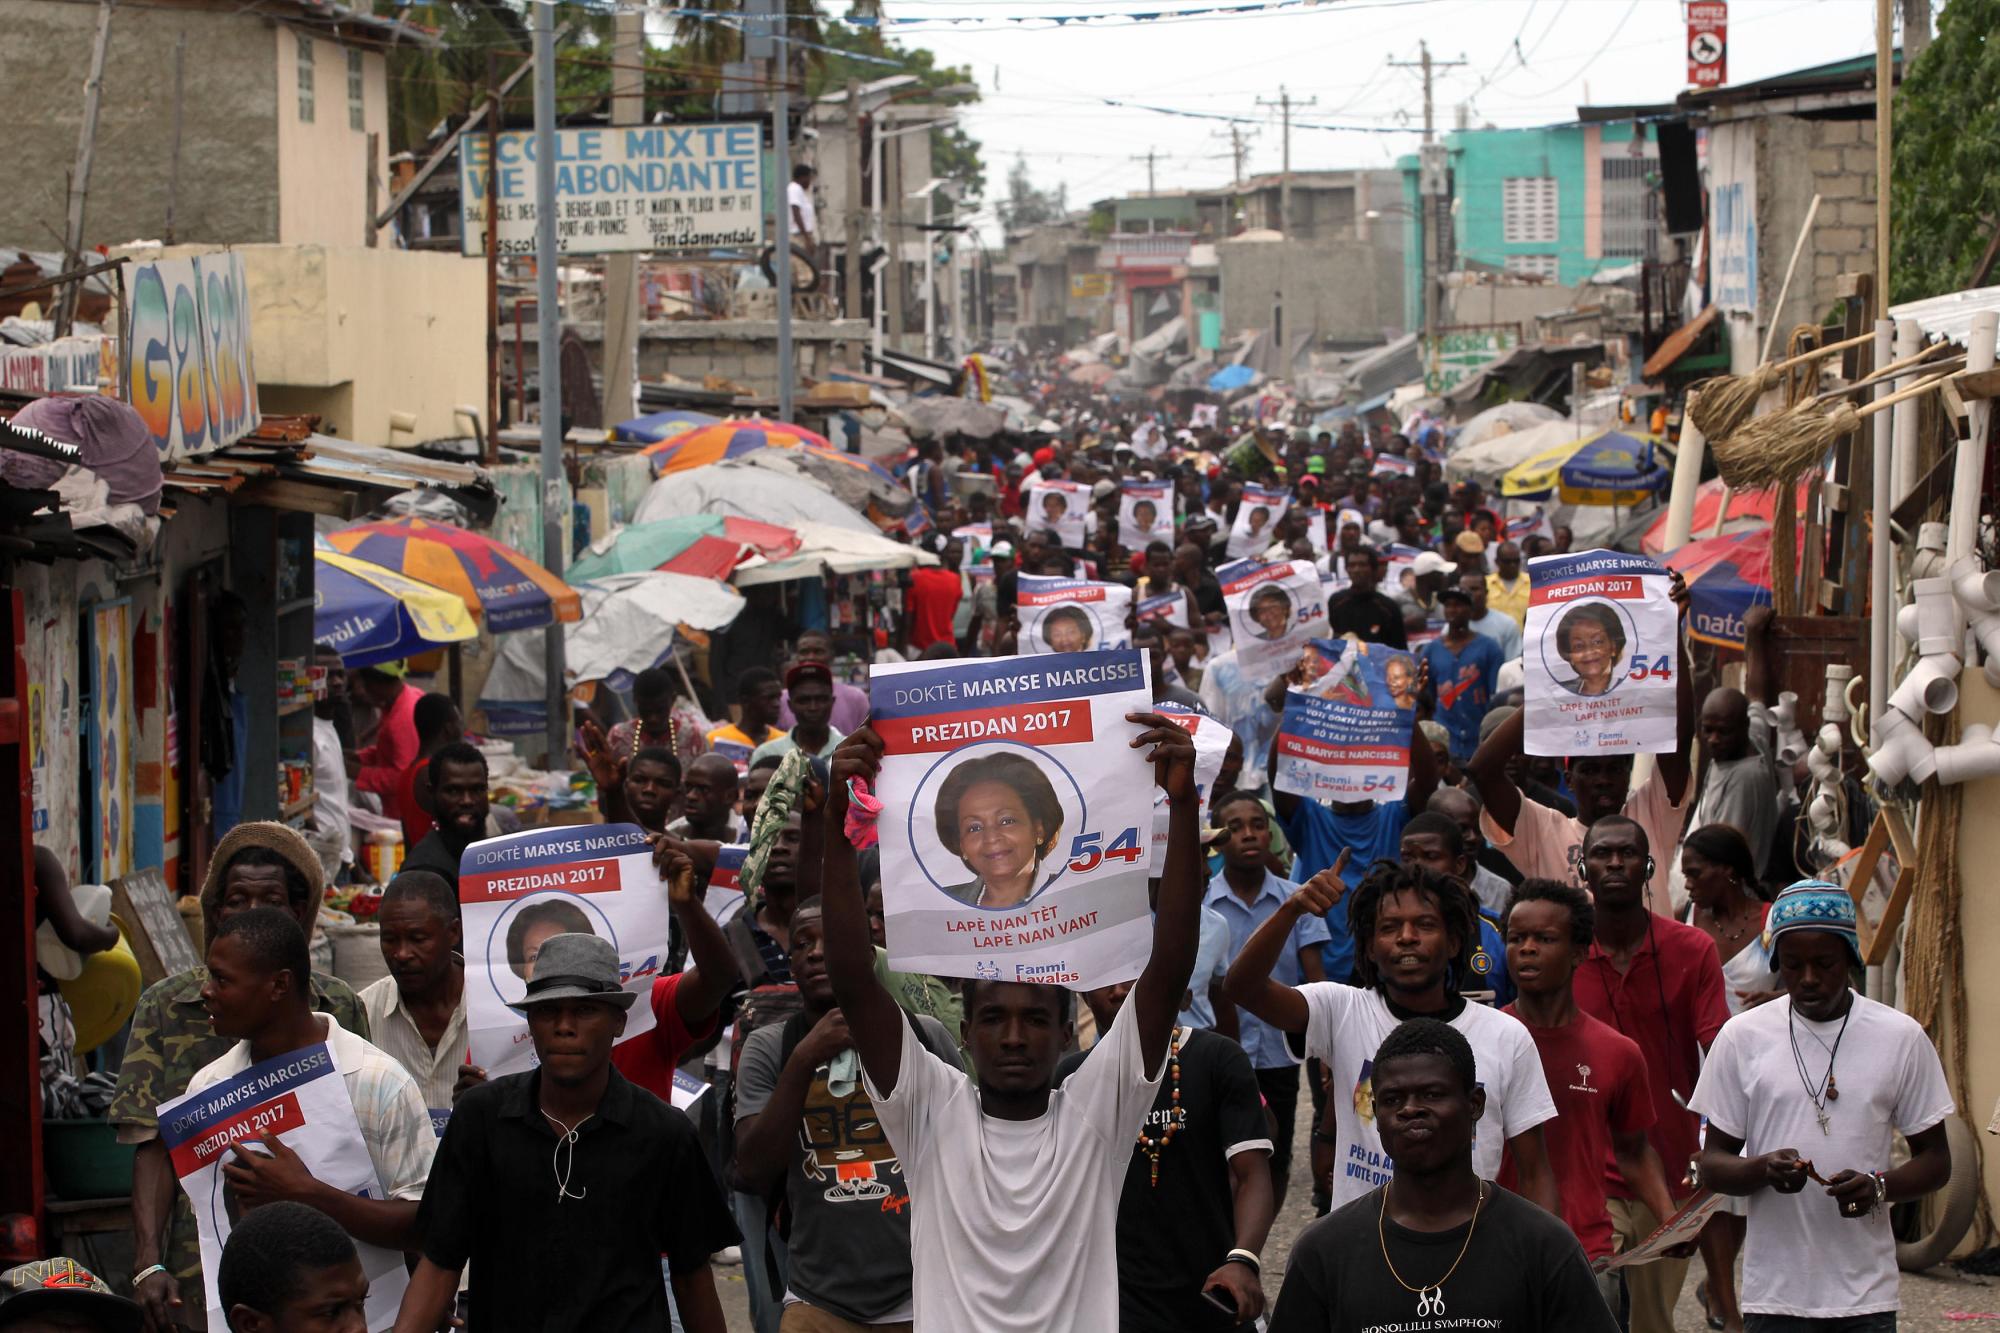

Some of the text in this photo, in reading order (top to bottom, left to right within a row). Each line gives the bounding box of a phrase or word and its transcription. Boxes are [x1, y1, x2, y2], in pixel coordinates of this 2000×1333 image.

[625, 127, 755, 159] MIXTE
[556, 159, 756, 195] ABONDANTE
[1576, 558, 1619, 573] MARYSE
[1547, 581, 1633, 599] PREZIDAN 2017
[354, 615, 376, 633] la
[1297, 603, 1323, 624] 54
[1629, 655, 1672, 681] 54
[895, 662, 1140, 706] DOKTÈ MARYSE NARCISSE
[1620, 706, 1645, 717] VANT
[911, 709, 1072, 745] PREZIDAN 2017
[1305, 745, 1347, 760] MARYSE
[1349, 750, 1401, 760] NARCISSE
[1315, 773, 1397, 792] Fanmi 54
[1315, 781, 1361, 792] Lavalas
[477, 832, 647, 865] DOKTÈ MARYSE NARCISS
[1067, 826, 1144, 874] 54
[487, 866, 606, 894] PREZIDAN 2017
[946, 905, 1059, 932] LAPÈ NAN TÈT
[973, 911, 1100, 949] LAPÈ NAN VANT
[1015, 960, 1066, 975] Fanmi
[1015, 970, 1081, 984] Lavalas
[172, 1051, 328, 1135] DOKTÈ MARYSE NARCISSE
[193, 1103, 286, 1159] PREZIDAN 2017
[1367, 1151, 1380, 1167] LA
[1346, 1161, 1372, 1183] VOTE
[1361, 1318, 1503, 1333] HONOLULU SYMPHONY
